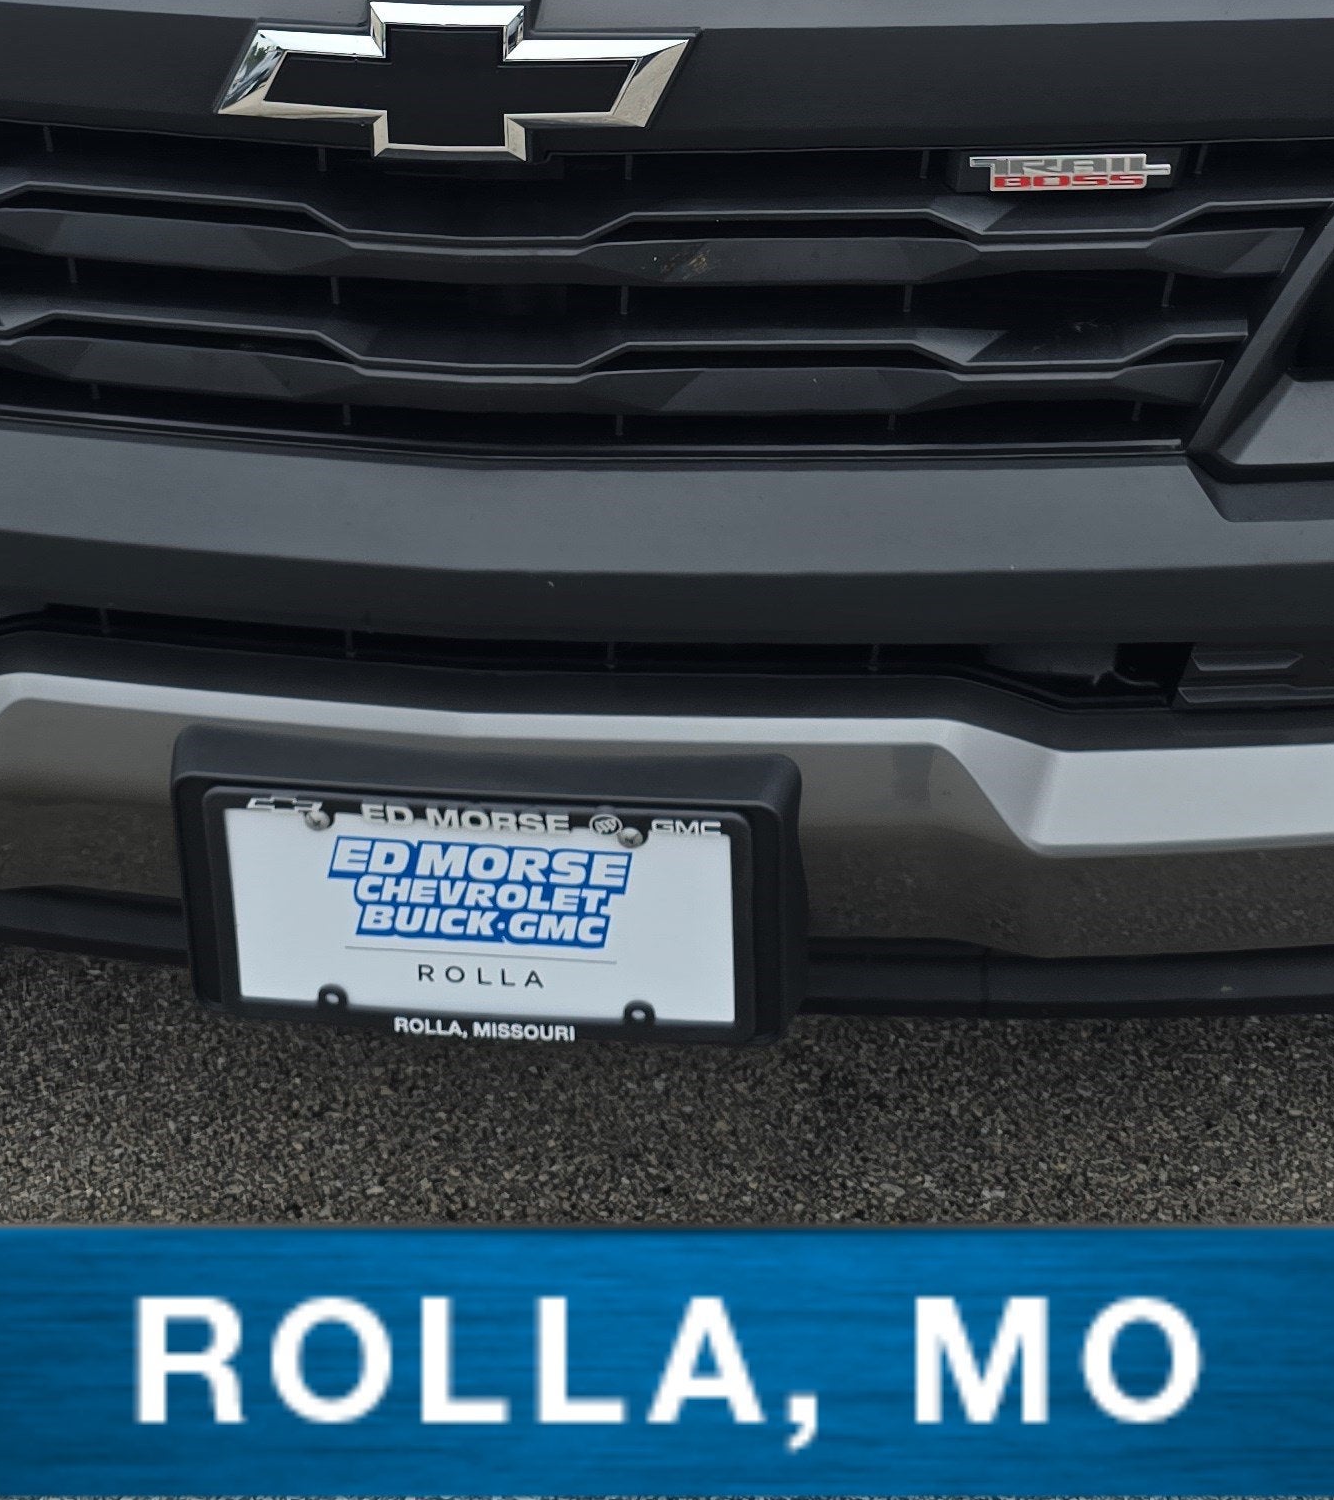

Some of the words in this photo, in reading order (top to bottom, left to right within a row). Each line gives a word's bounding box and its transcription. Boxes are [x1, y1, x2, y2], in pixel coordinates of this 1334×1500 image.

[970, 154, 1171, 176] TRAIL
[991, 174, 1147, 191] BOSS
[361, 803, 415, 828] ED
[426, 808, 570, 835] MORSE
[651, 819, 722, 836] GMC
[331, 837, 411, 874] ED
[415, 843, 630, 887] MORSE
[418, 964, 544, 988] ROLLA
[394, 1016, 468, 1039] ROLLA,
[473, 1021, 575, 1042] MISSOURI
